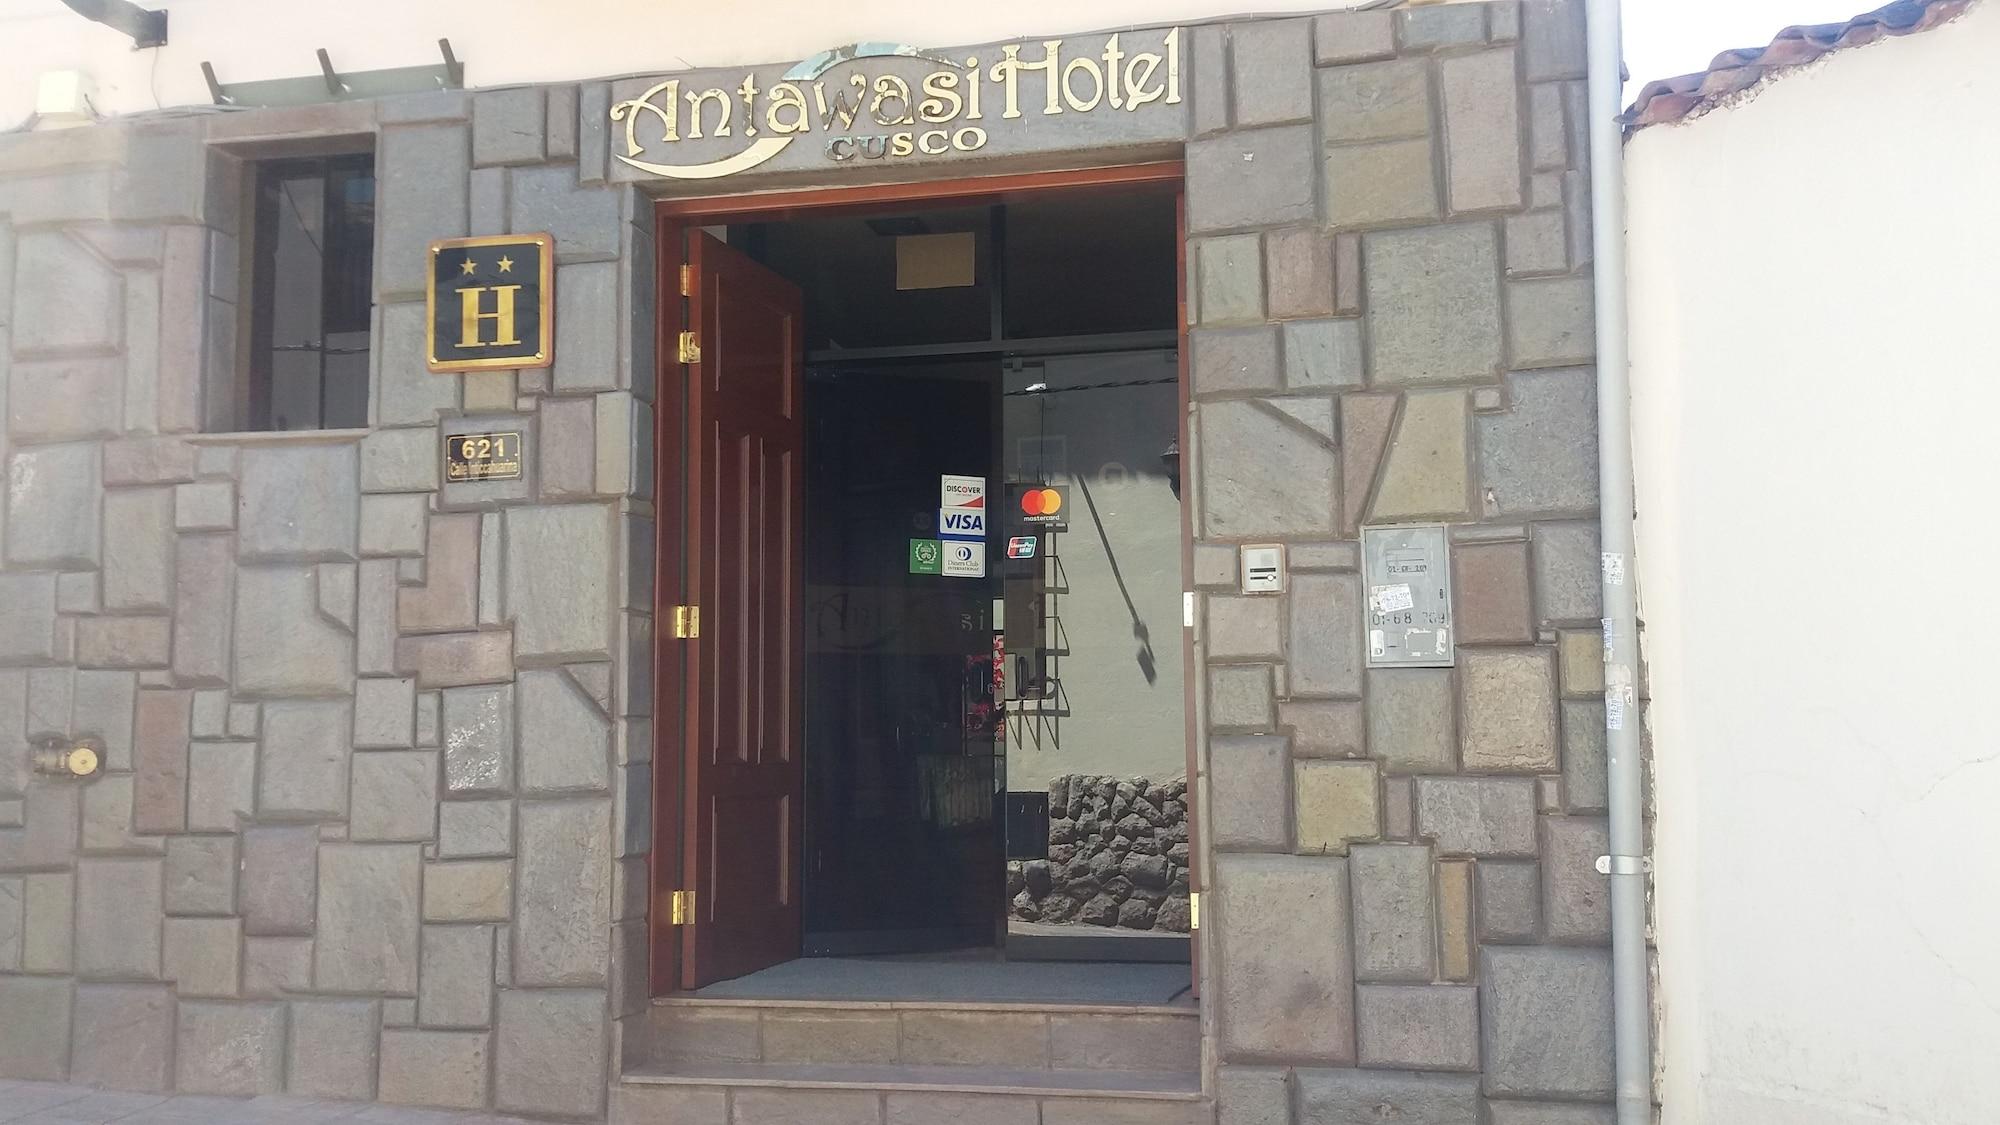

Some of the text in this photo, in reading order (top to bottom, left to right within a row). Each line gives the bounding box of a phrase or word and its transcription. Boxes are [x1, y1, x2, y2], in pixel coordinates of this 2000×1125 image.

[609, 26, 1182, 158] Antawasi Hotel
[824, 127, 988, 161] CUSCO
[454, 284, 522, 348] H
[462, 438, 504, 460] 621
[946, 484, 981, 494] DISCOVER
[944, 513, 983, 531] VISA
